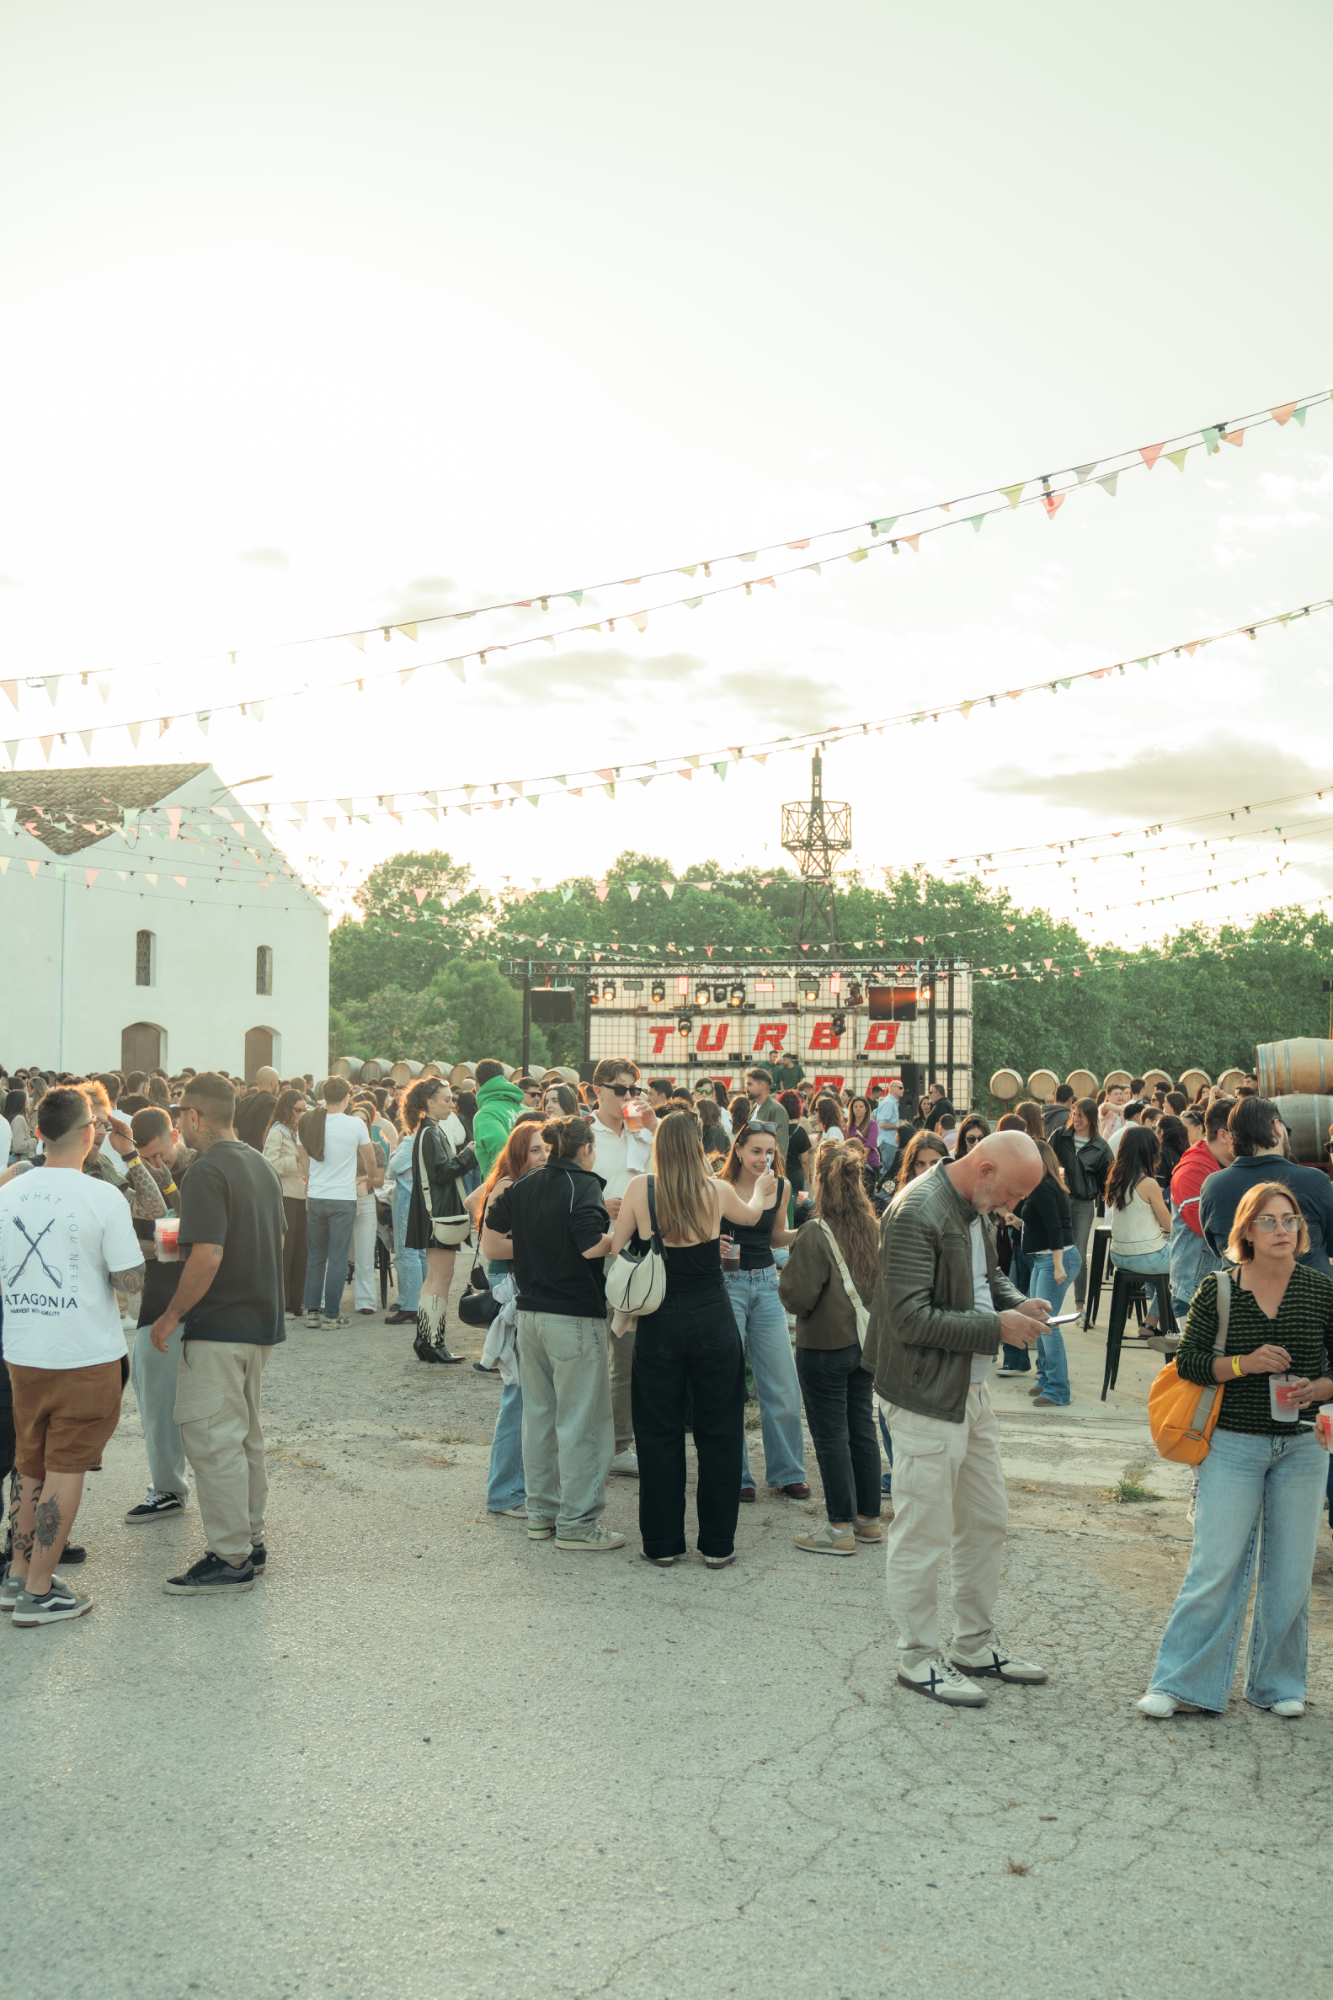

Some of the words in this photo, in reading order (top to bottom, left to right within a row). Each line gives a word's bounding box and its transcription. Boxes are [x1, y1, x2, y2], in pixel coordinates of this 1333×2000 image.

[649, 1022, 901, 1054] TURBO
[19, 1191, 63, 1205] WHAT
[66, 1212, 79, 1243] YOU
[69, 1253, 79, 1293] NEED
[5, 1293, 78, 1308] ATAGONIA
